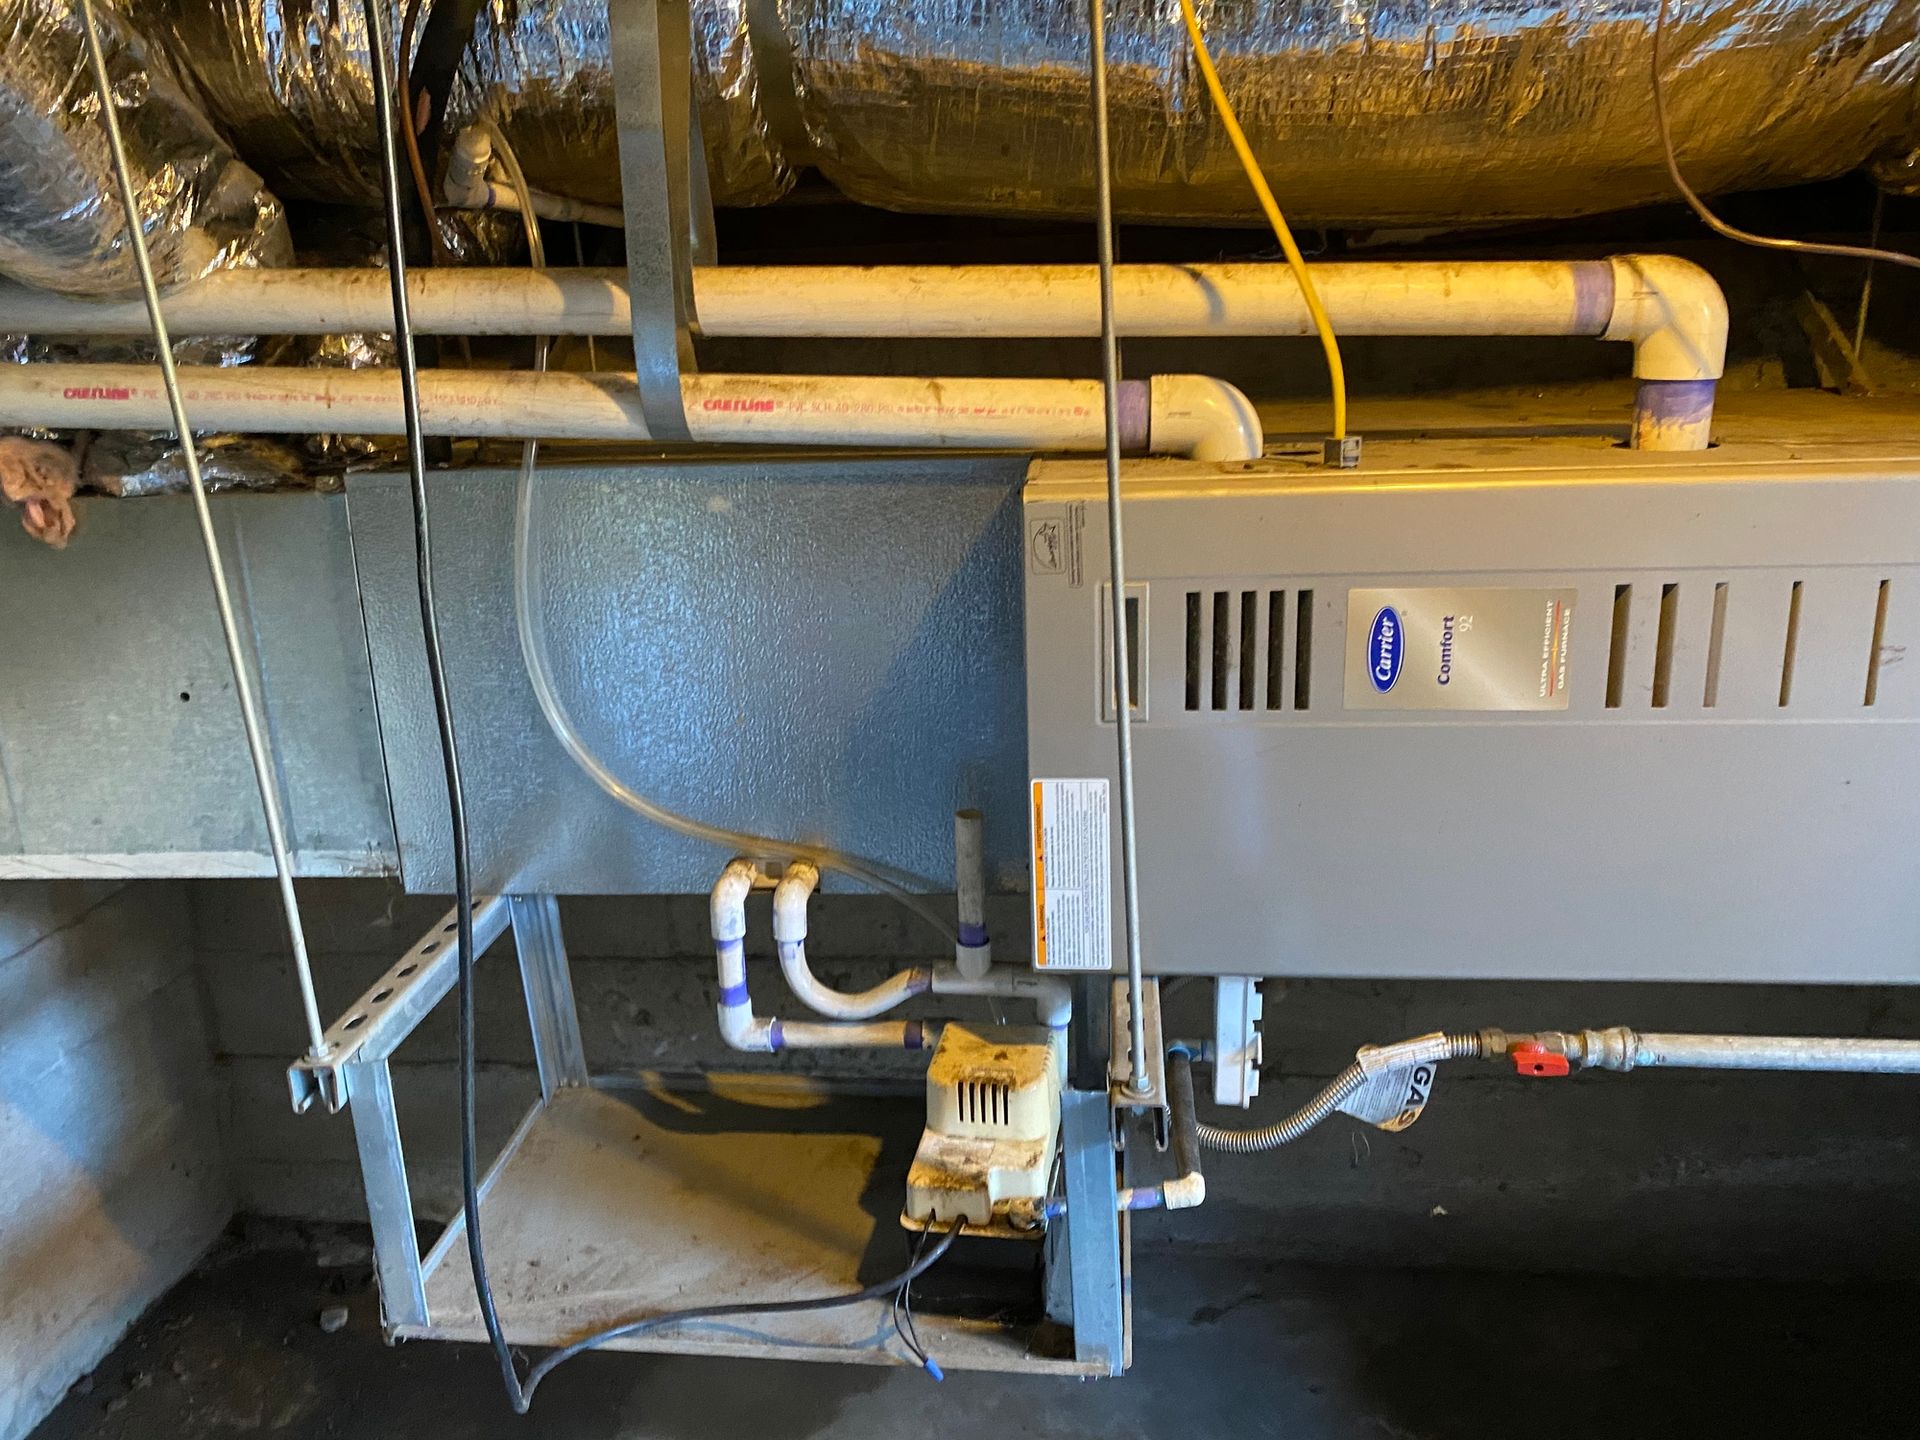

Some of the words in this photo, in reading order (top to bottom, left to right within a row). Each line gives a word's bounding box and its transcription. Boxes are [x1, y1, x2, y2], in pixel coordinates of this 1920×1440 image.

[1375, 616, 1394, 681] Carrier
[1437, 615, 1454, 685] Comfort
[1459, 615, 1473, 632] 92
[1542, 600, 1553, 659] EFFICIENT
[1560, 608, 1571, 664] FURNACE
[1540, 660, 1549, 697] ULTRA
[1398, 1066, 1432, 1126] GAS
